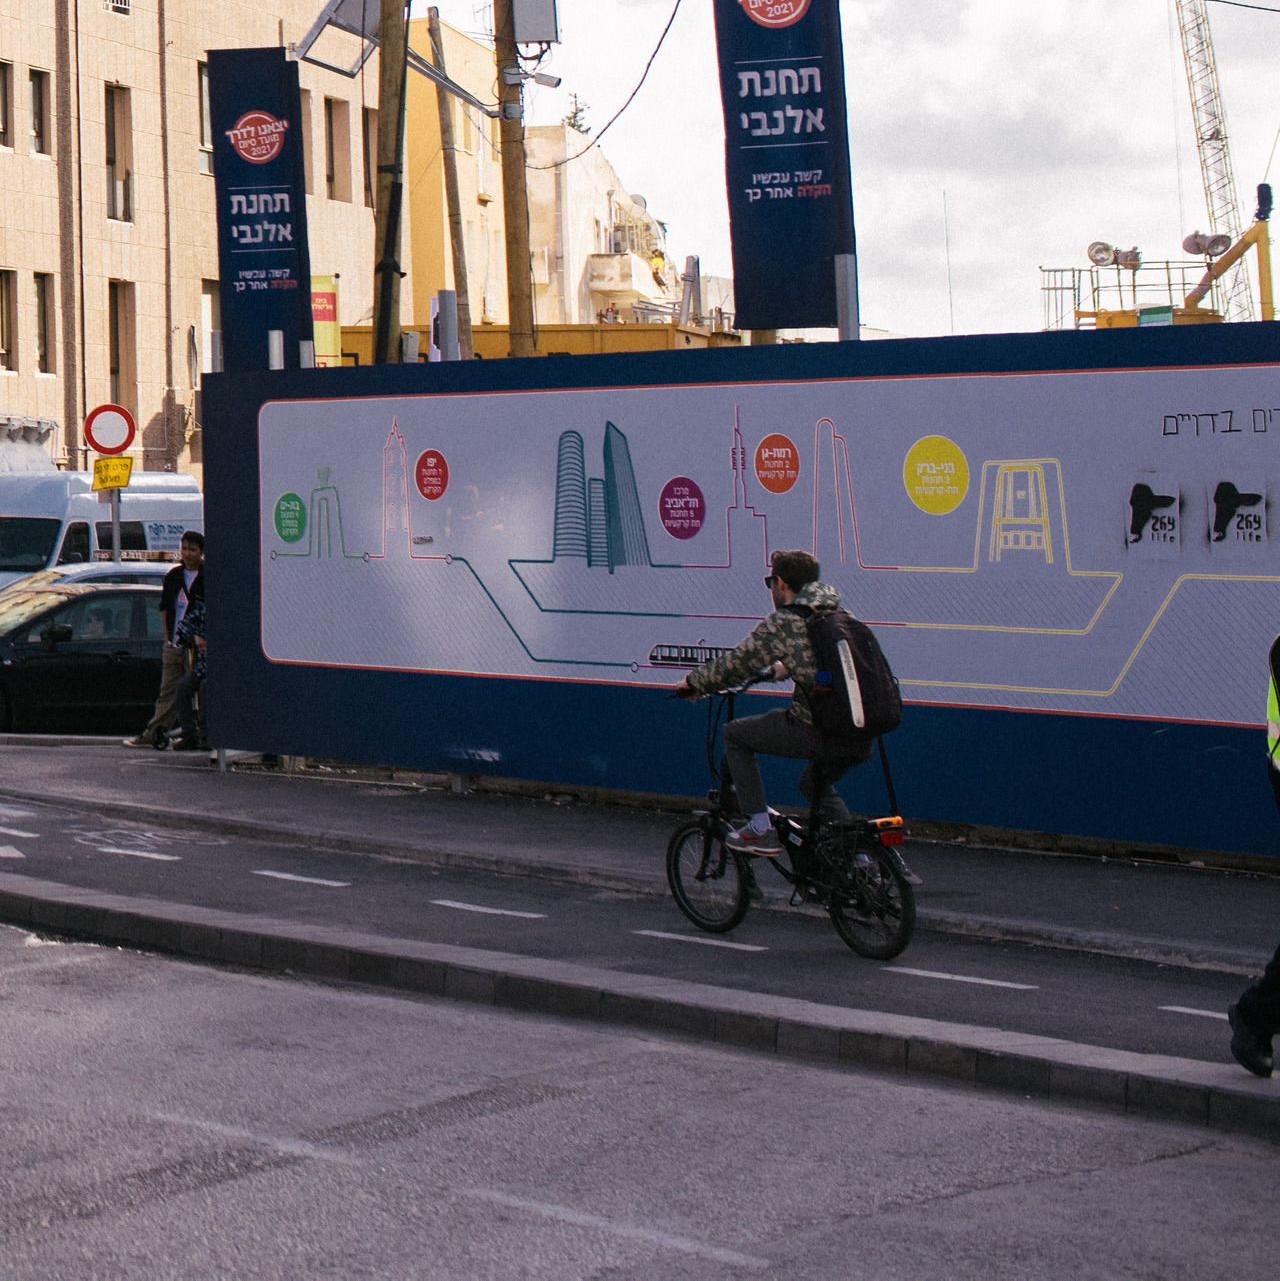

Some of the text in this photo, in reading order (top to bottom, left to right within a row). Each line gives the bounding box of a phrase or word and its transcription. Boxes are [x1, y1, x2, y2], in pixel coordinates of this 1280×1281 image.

[767, 2, 794, 17] 2021
[738, 67, 822, 98] תחנת
[741, 104, 825, 136] אלנבי
[251, 145, 271, 156] 2021
[752, 170, 822, 186] קשה עכשיו
[745, 189, 761, 203] כך
[766, 187, 793, 199] אחר
[230, 193, 290, 215] תחנת
[232, 221, 292, 243] אלנבי
[1253, 408, 1280, 432] ים
[1151, 532, 1175, 543] life
[1236, 531, 1261, 542] life
